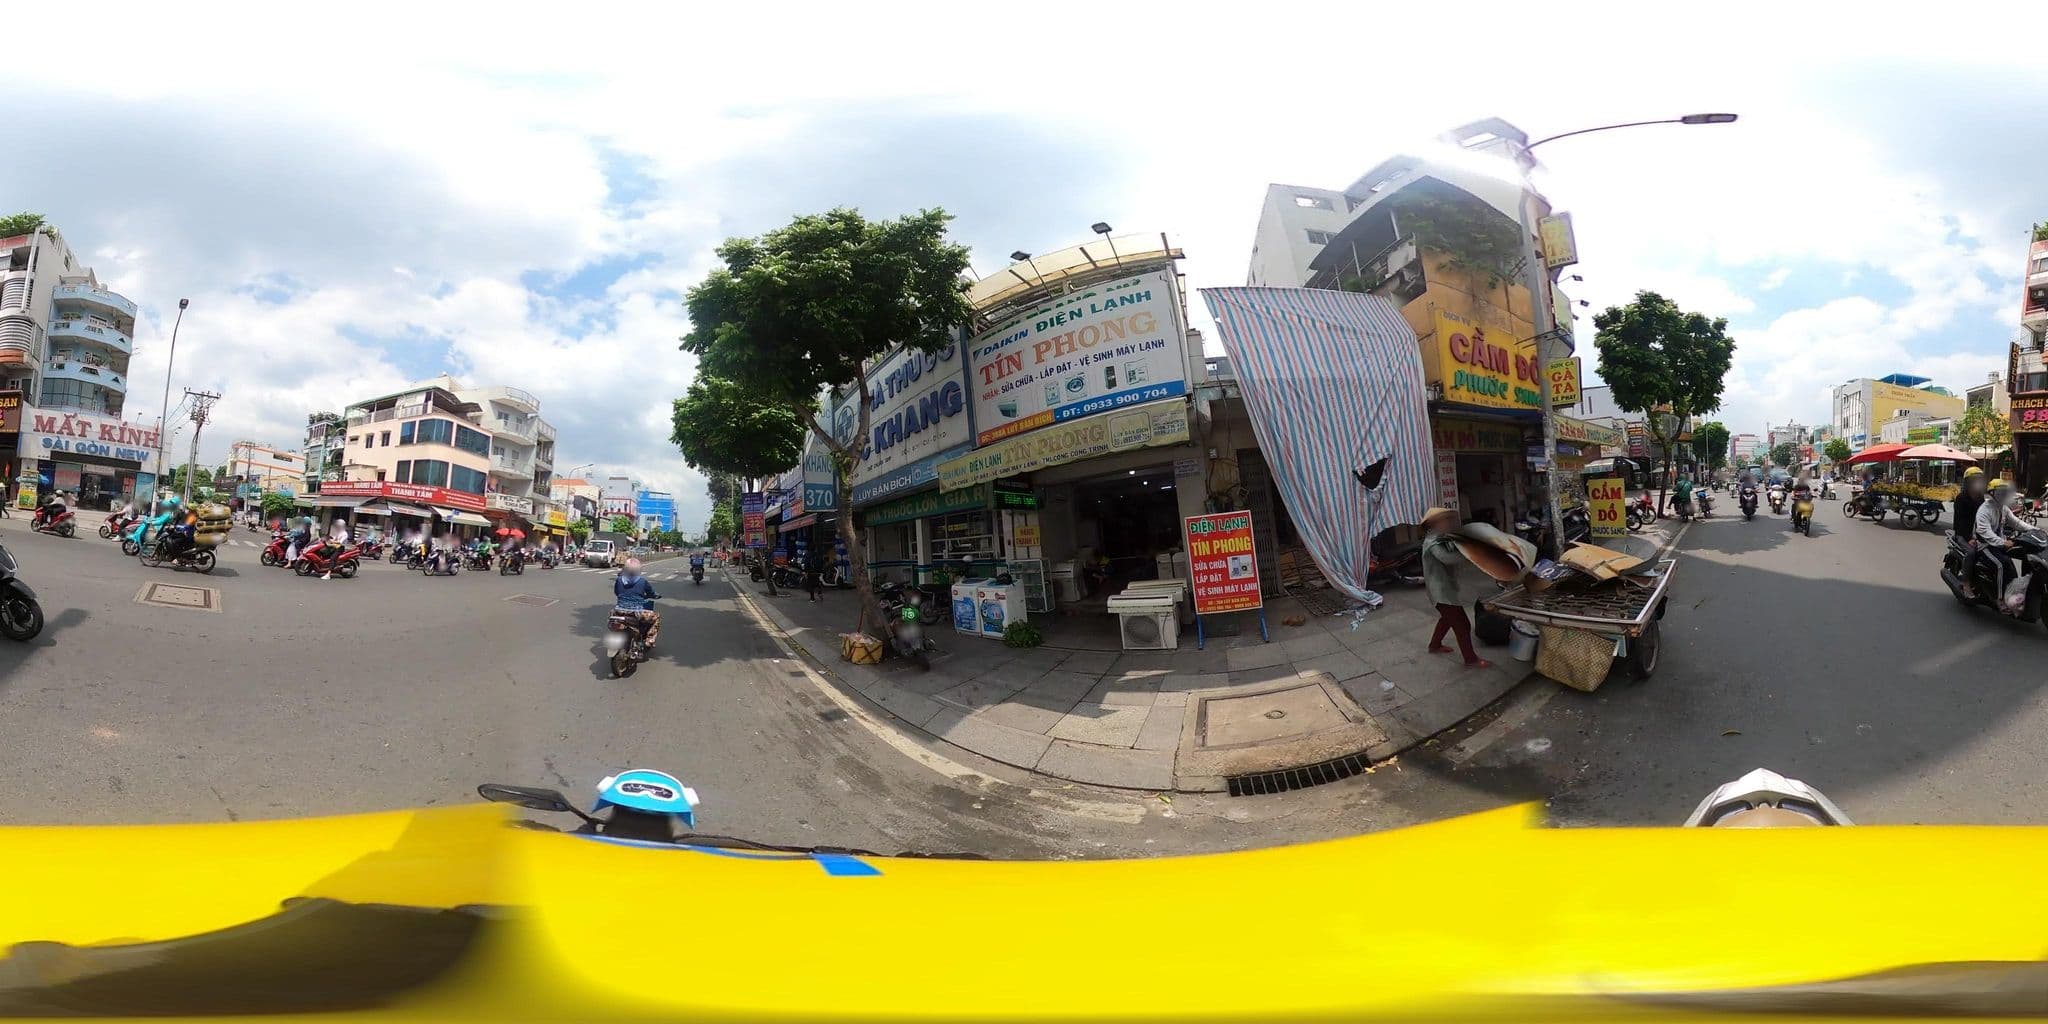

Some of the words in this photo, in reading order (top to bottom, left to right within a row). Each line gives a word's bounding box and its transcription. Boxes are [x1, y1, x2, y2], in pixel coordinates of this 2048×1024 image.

[983, 329, 1029, 356] DAIKIN
[1036, 307, 1083, 333] ĐIỆN
[1090, 289, 1152, 314] LẠNH
[979, 350, 1023, 386] TÍN
[1033, 312, 1157, 365] PHONG
[1449, 327, 1510, 376] CẦM
[1001, 380, 1014, 393] SỬA
[1015, 374, 1034, 388] CHỮA
[1039, 366, 1054, 379] LẮP
[1056, 361, 1072, 374] ĐẶT
[1079, 353, 1090, 367] VỆ
[1093, 350, 1114, 363] SINH
[1116, 343, 1136, 357] MÁY
[1139, 338, 1165, 352] LẠNH
[2011, 343, 2020, 384] HOTEL
[1552, 367, 1575, 383] GÀ
[1552, 382, 1575, 394] TA
[1062, 409, 1081, 418] ĐT:
[1083, 399, 1113, 412] 0933
[1115, 393, 1140, 405] 900
[1143, 387, 1168, 399] 704
[874, 381, 963, 454] KHANG
[98, 421, 161, 449] KÍNH
[42, 436, 69, 451] SÀI
[75, 440, 110, 455] GÒN
[115, 447, 149, 462] NEW
[805, 454, 833, 473] KHANG
[391, 486, 417, 497] THANH
[417, 489, 433, 499] TÂM
[806, 489, 833, 506] 370
[973, 485, 985, 502] R
[1190, 518, 1216, 536] ĐIỆN
[1218, 516, 1249, 535] LẠNH
[1191, 538, 1211, 556] TÍN
[1212, 536, 1252, 554] PHONG
[1194, 560, 1208, 571] SỬA
[1208, 559, 1227, 570] CHỮA
[1195, 573, 1208, 584] LẮP
[1209, 572, 1222, 583] ĐẶT
[1197, 586, 1207, 596] VỆ
[1207, 586, 1224, 595] SINH
[1224, 584, 1239, 593] MÁY
[1240, 582, 1258, 593] LẠNH
